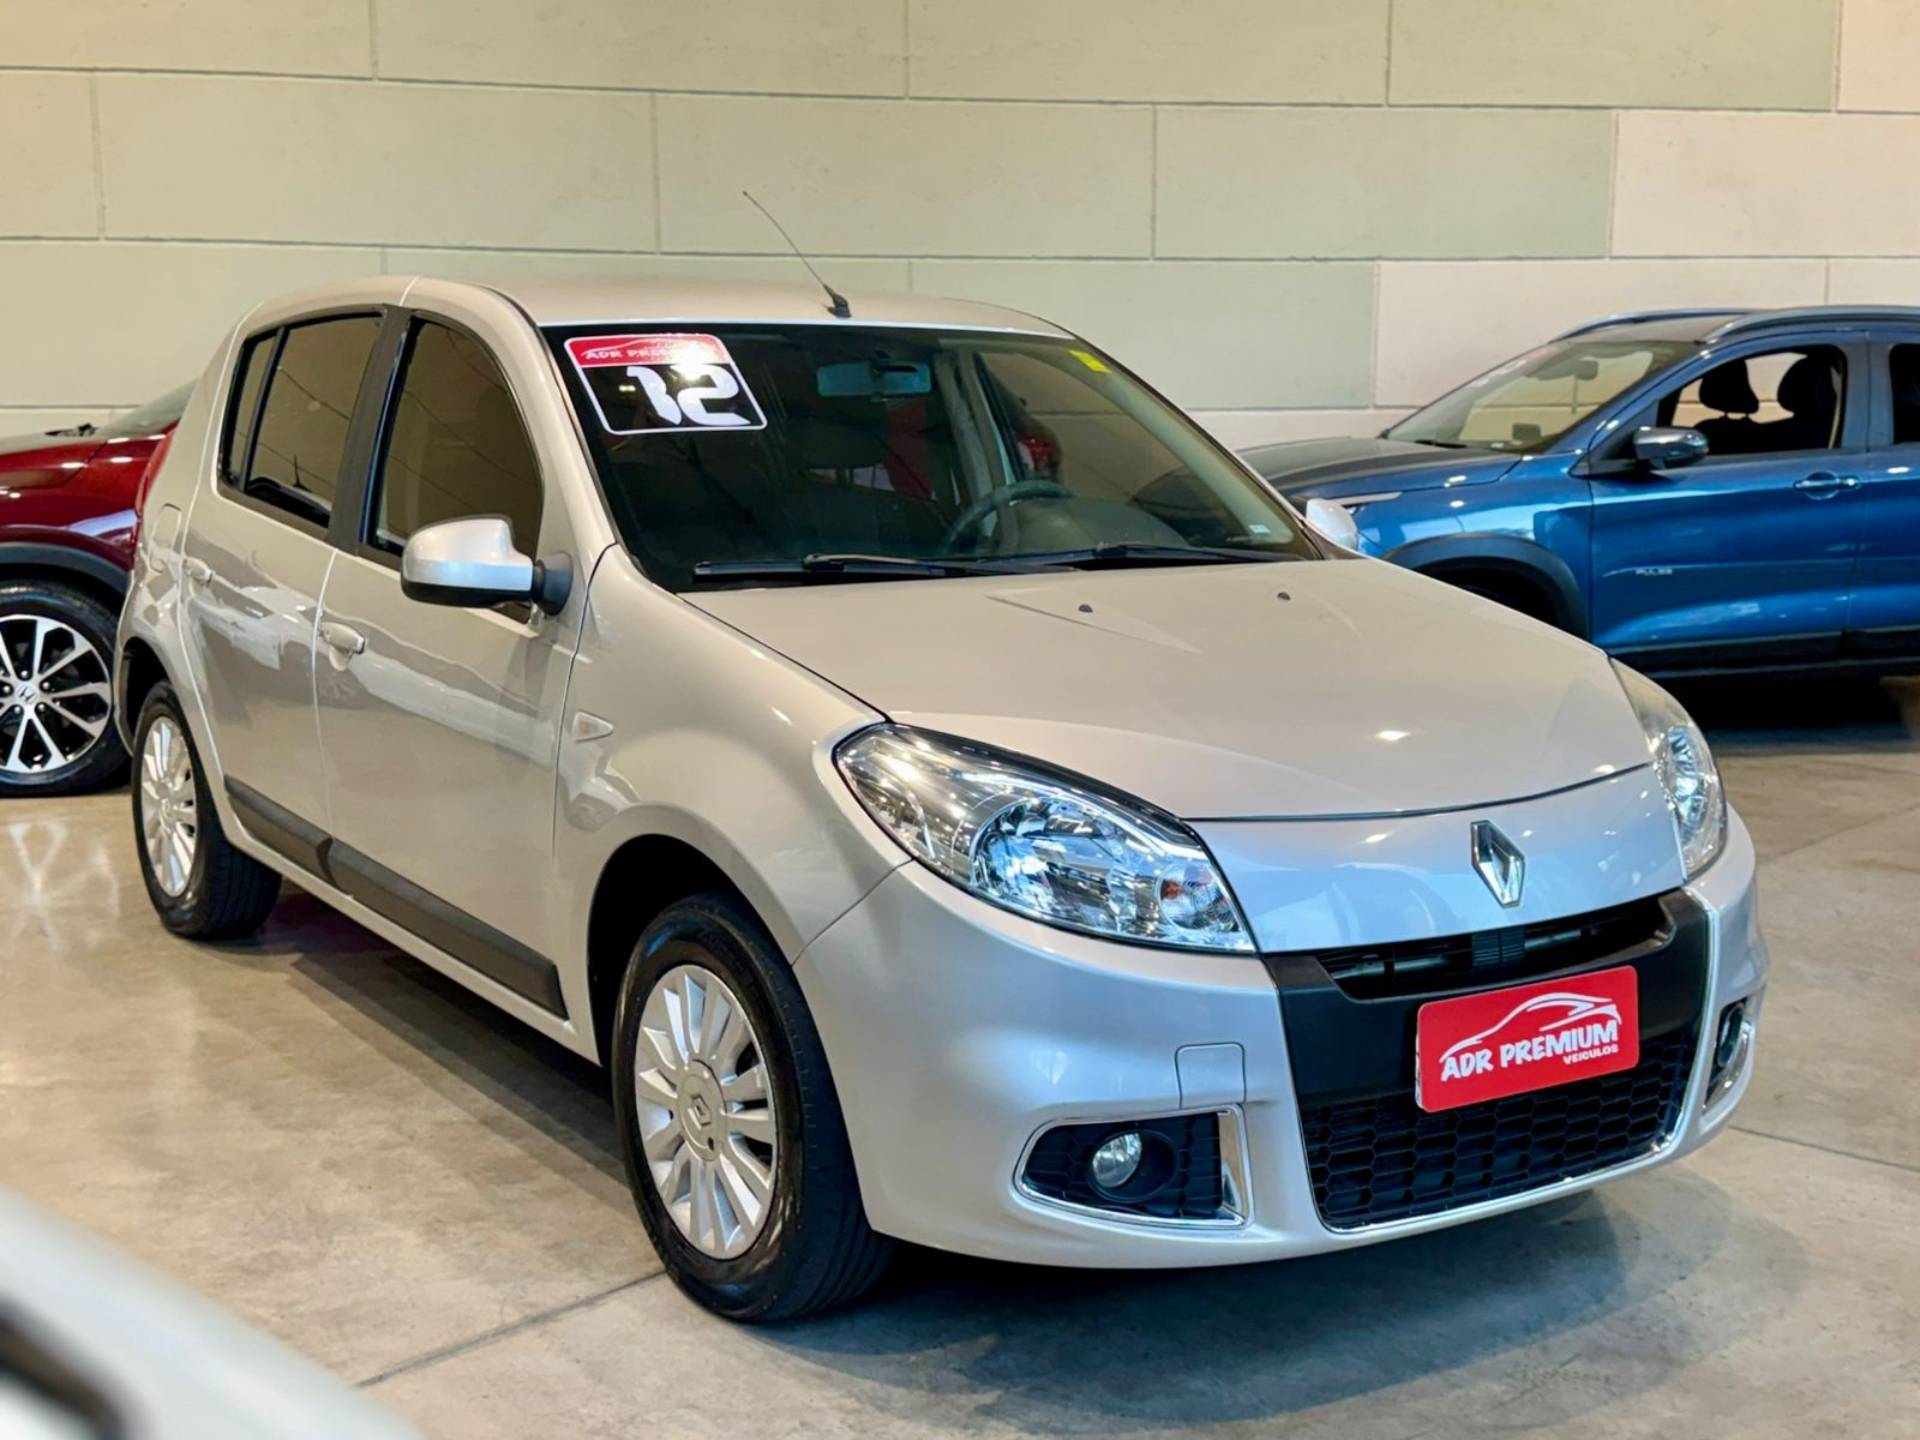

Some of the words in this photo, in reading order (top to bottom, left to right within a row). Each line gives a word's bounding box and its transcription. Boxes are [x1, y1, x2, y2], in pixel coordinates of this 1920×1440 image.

[586, 350, 623, 360] ADR
[626, 364, 751, 426] 12
[1440, 1049, 1494, 1082] ADR
[1500, 1020, 1619, 1068] PREMIUM
[1563, 1044, 1619, 1065] VEICULOS
